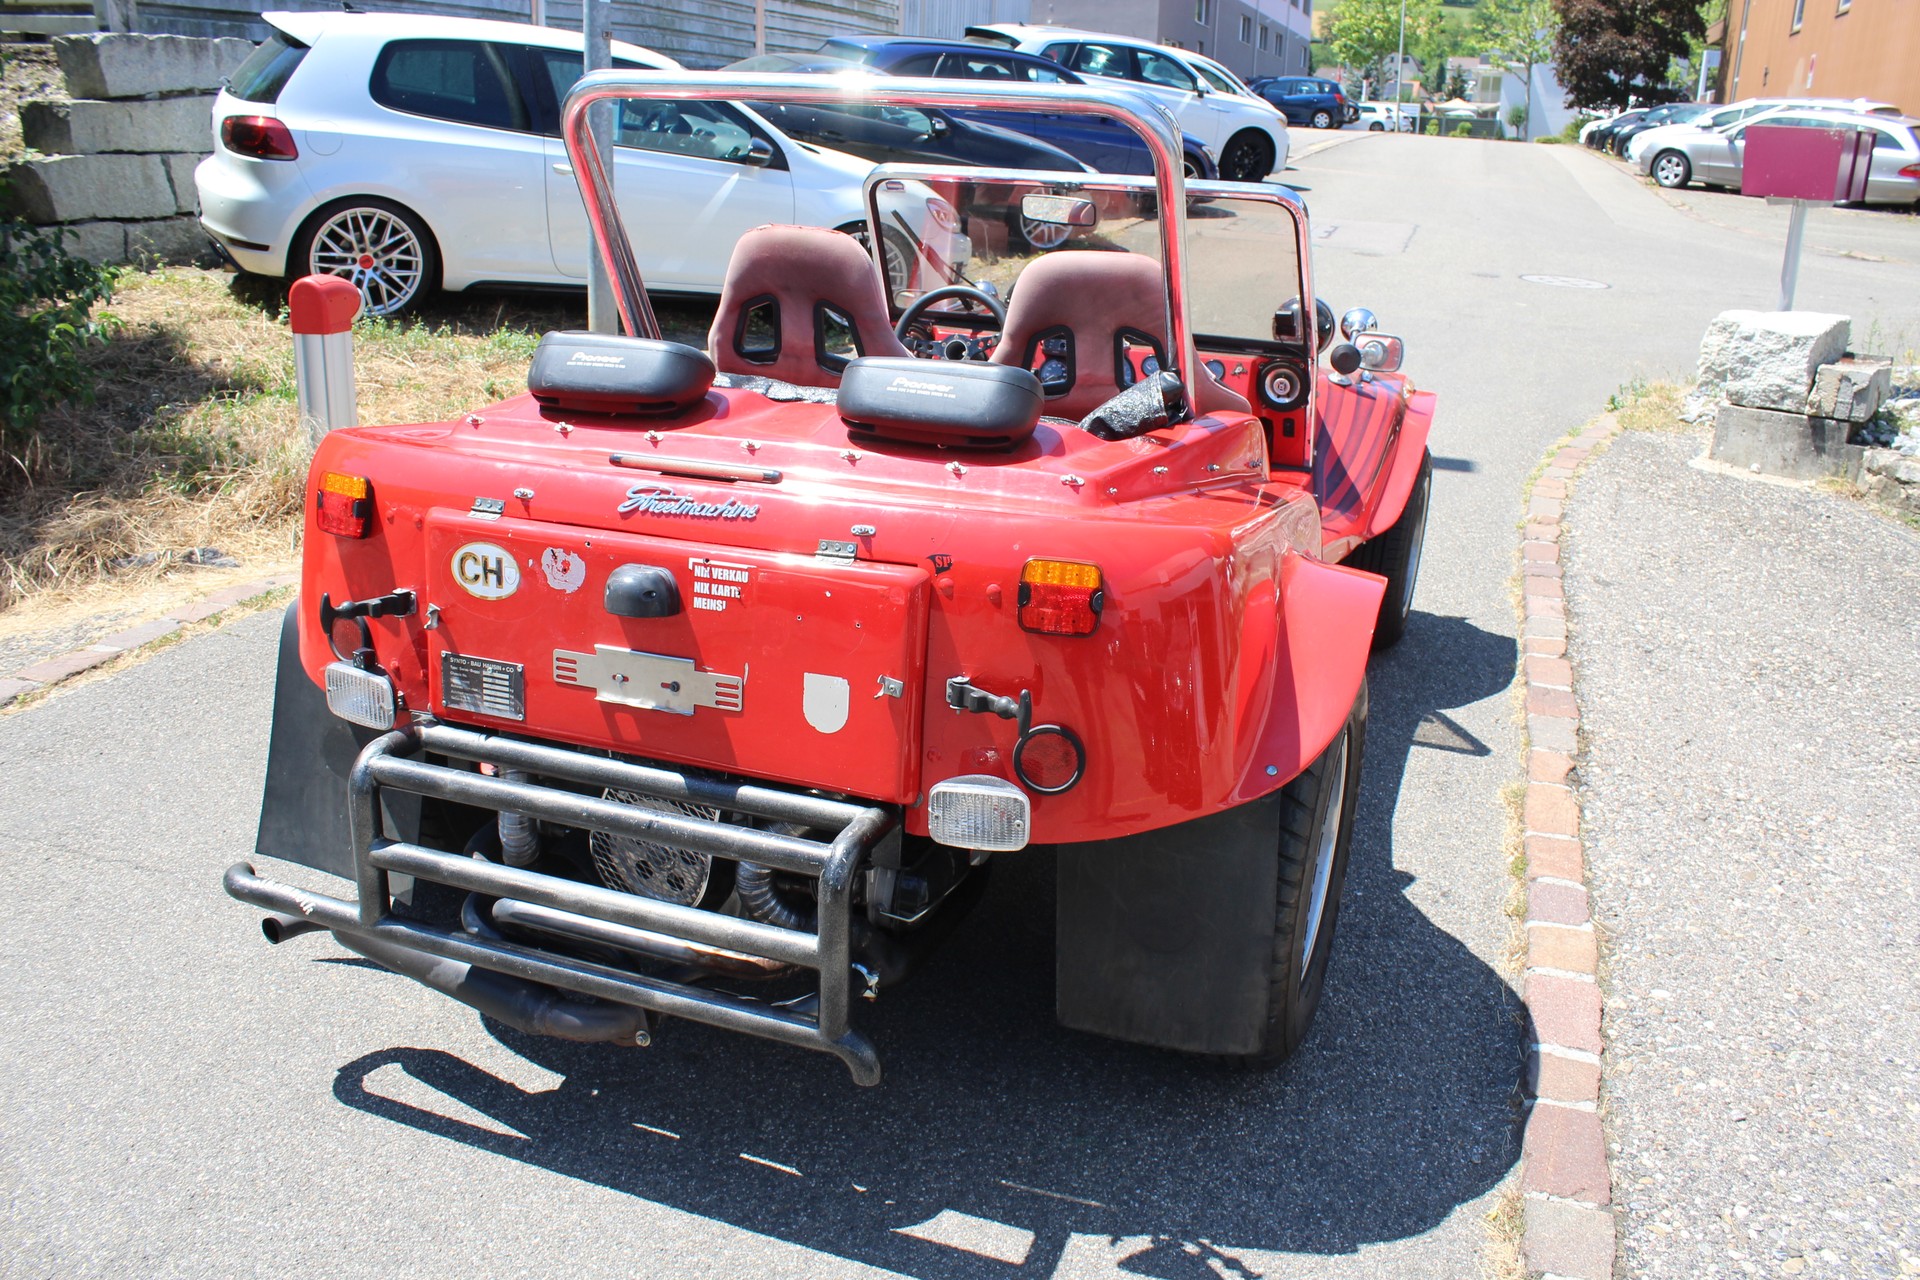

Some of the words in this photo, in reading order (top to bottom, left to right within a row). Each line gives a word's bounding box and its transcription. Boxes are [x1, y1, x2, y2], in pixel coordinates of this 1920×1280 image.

[571, 351, 625, 363] Pioneer
[892, 376, 954, 393] Pioneer
[617, 484, 760, 518] Streetmachine
[458, 551, 504, 589] CH
[694, 565, 710, 579] NIX
[711, 567, 749, 583] VERKAU
[694, 581, 710, 595] NIX
